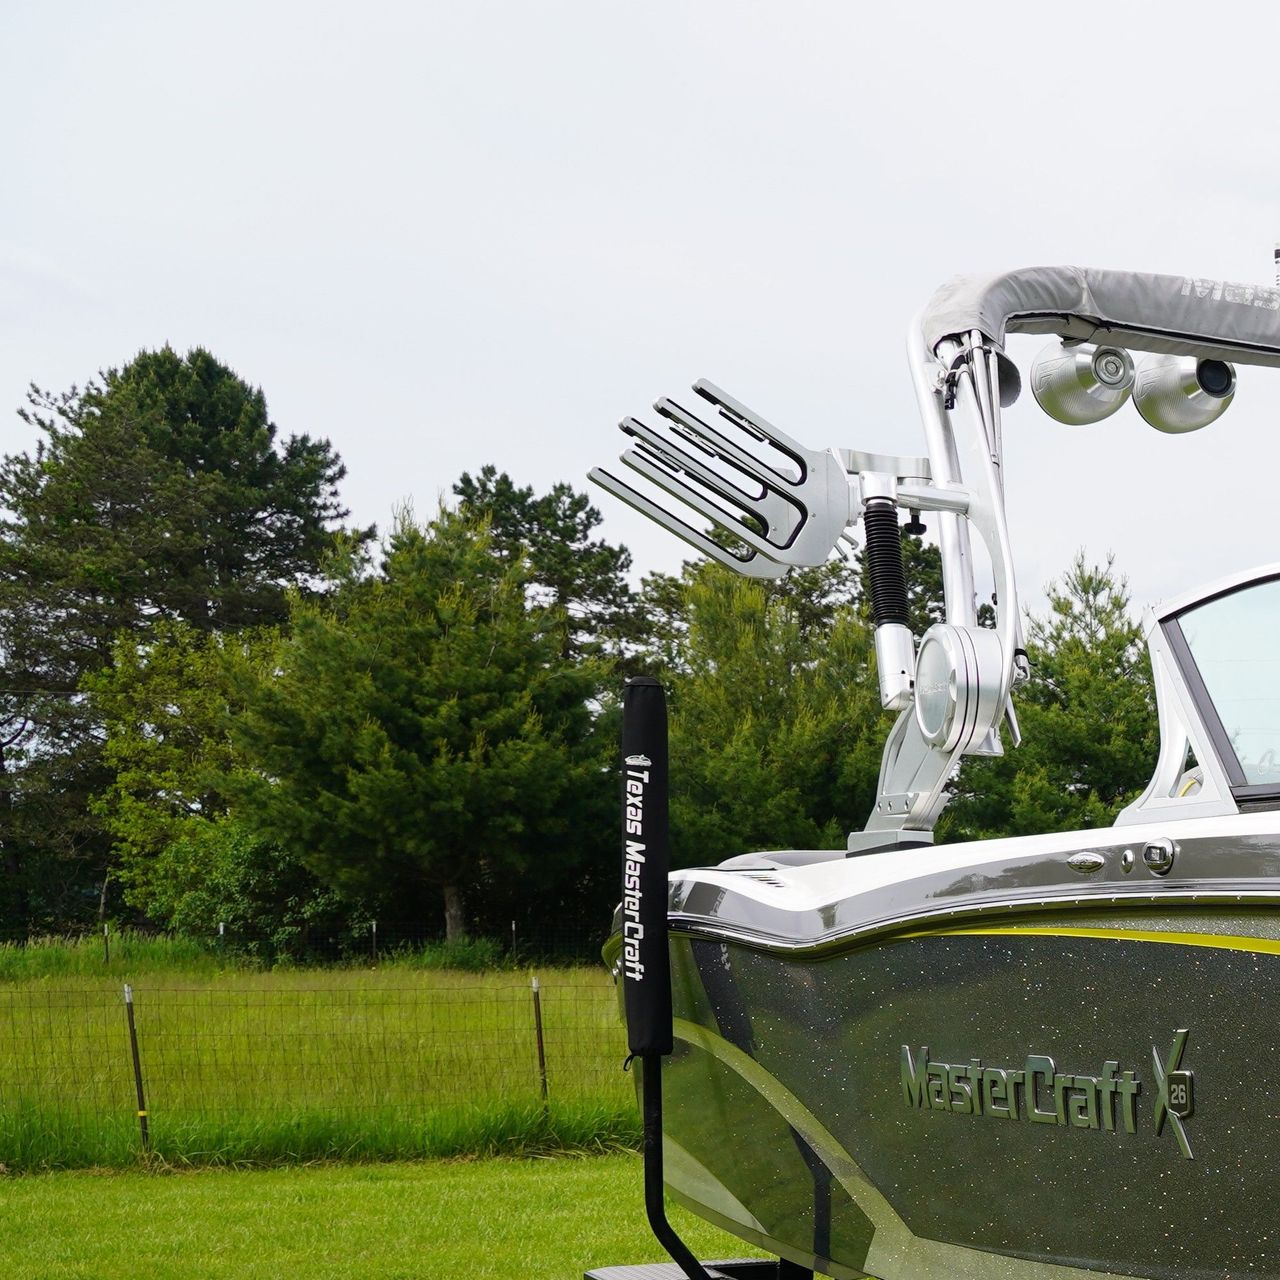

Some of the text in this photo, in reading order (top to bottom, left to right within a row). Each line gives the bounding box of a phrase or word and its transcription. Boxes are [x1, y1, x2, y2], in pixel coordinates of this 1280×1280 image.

[624, 770, 650, 982] Texas MasterCraft
[900, 1044, 1142, 1135] MasterCraft
